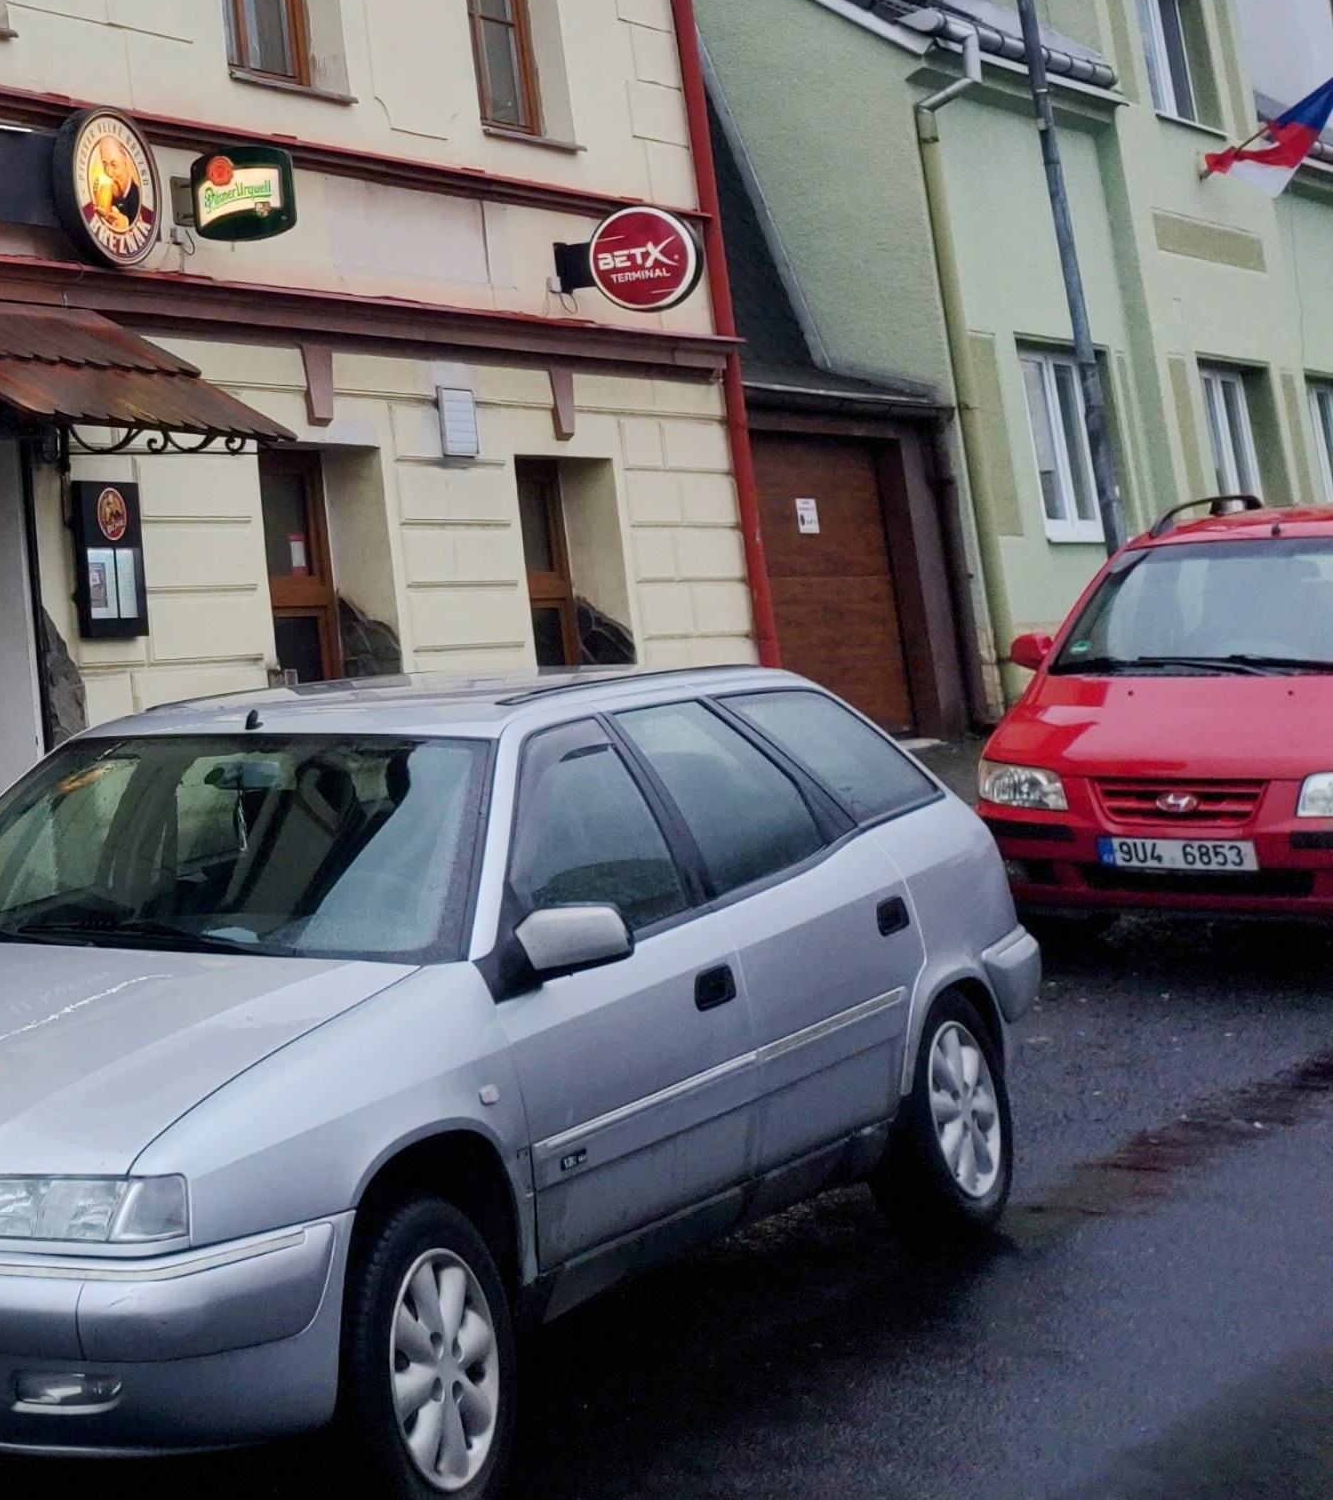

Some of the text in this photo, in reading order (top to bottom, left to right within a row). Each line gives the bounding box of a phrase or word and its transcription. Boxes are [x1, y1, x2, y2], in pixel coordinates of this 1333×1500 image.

[204, 180, 272, 214] Pilsner Urquell
[597, 235, 680, 271] BETX
[610, 267, 672, 284] TERMINAL
[1118, 841, 1244, 867] 9U4 6853
